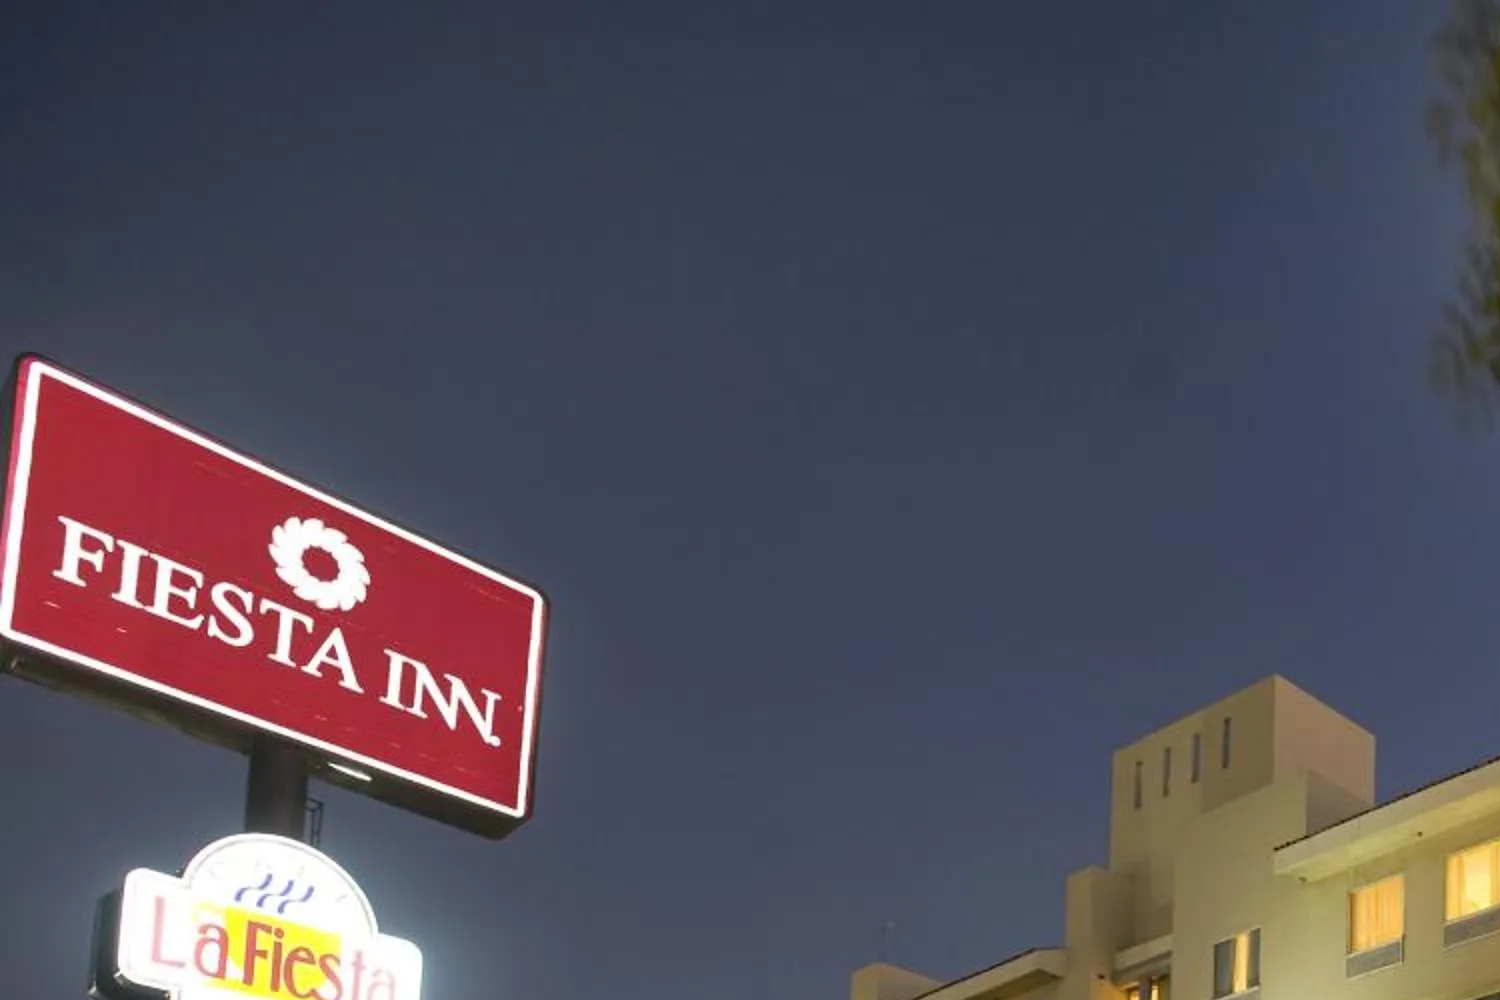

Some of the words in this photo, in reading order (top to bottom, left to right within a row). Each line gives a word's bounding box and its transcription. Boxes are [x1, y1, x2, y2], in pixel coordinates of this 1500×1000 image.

[52, 515, 364, 693] FIESTA
[379, 649, 502, 747] INN
[151, 896, 229, 980] La
